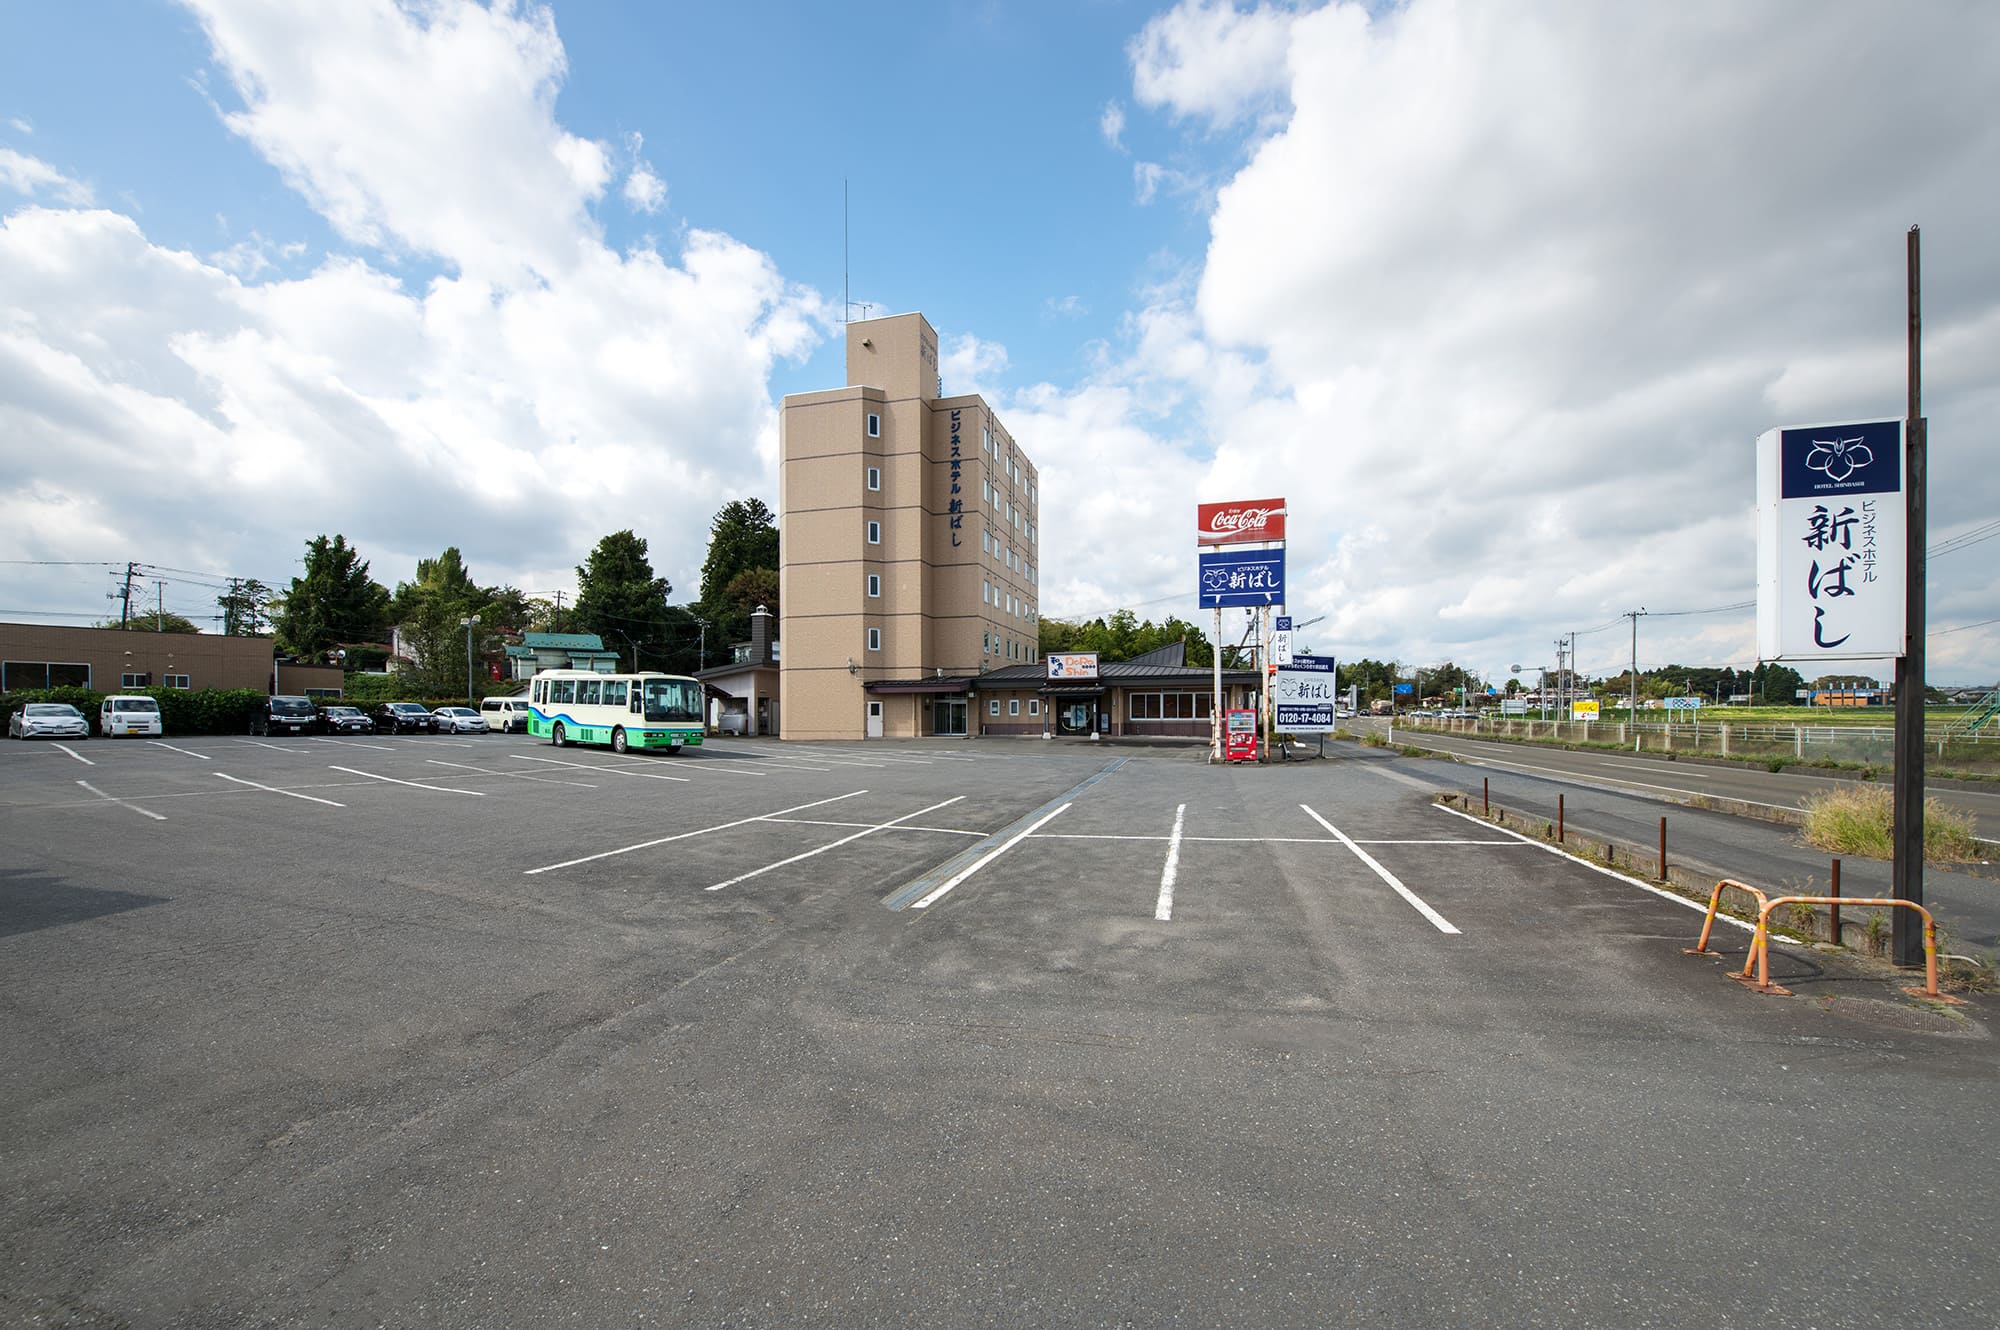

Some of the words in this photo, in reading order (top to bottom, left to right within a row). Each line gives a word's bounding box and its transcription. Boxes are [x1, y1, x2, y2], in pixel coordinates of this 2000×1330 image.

[950, 410, 961, 494] ビジネスホテル
[948, 498, 963, 548] 新ばし
[1211, 508, 1269, 531] Coca-Cola
[1862, 500, 1877, 583] ビジネスホテル
[1229, 570, 1280, 589] 新ばし
[1802, 505, 1860, 649] 新ばし
[1277, 633, 1287, 662] 新ばし
[1298, 682, 1331, 699] 新ばし
[1279, 712, 1331, 723] 0120-17-4084
